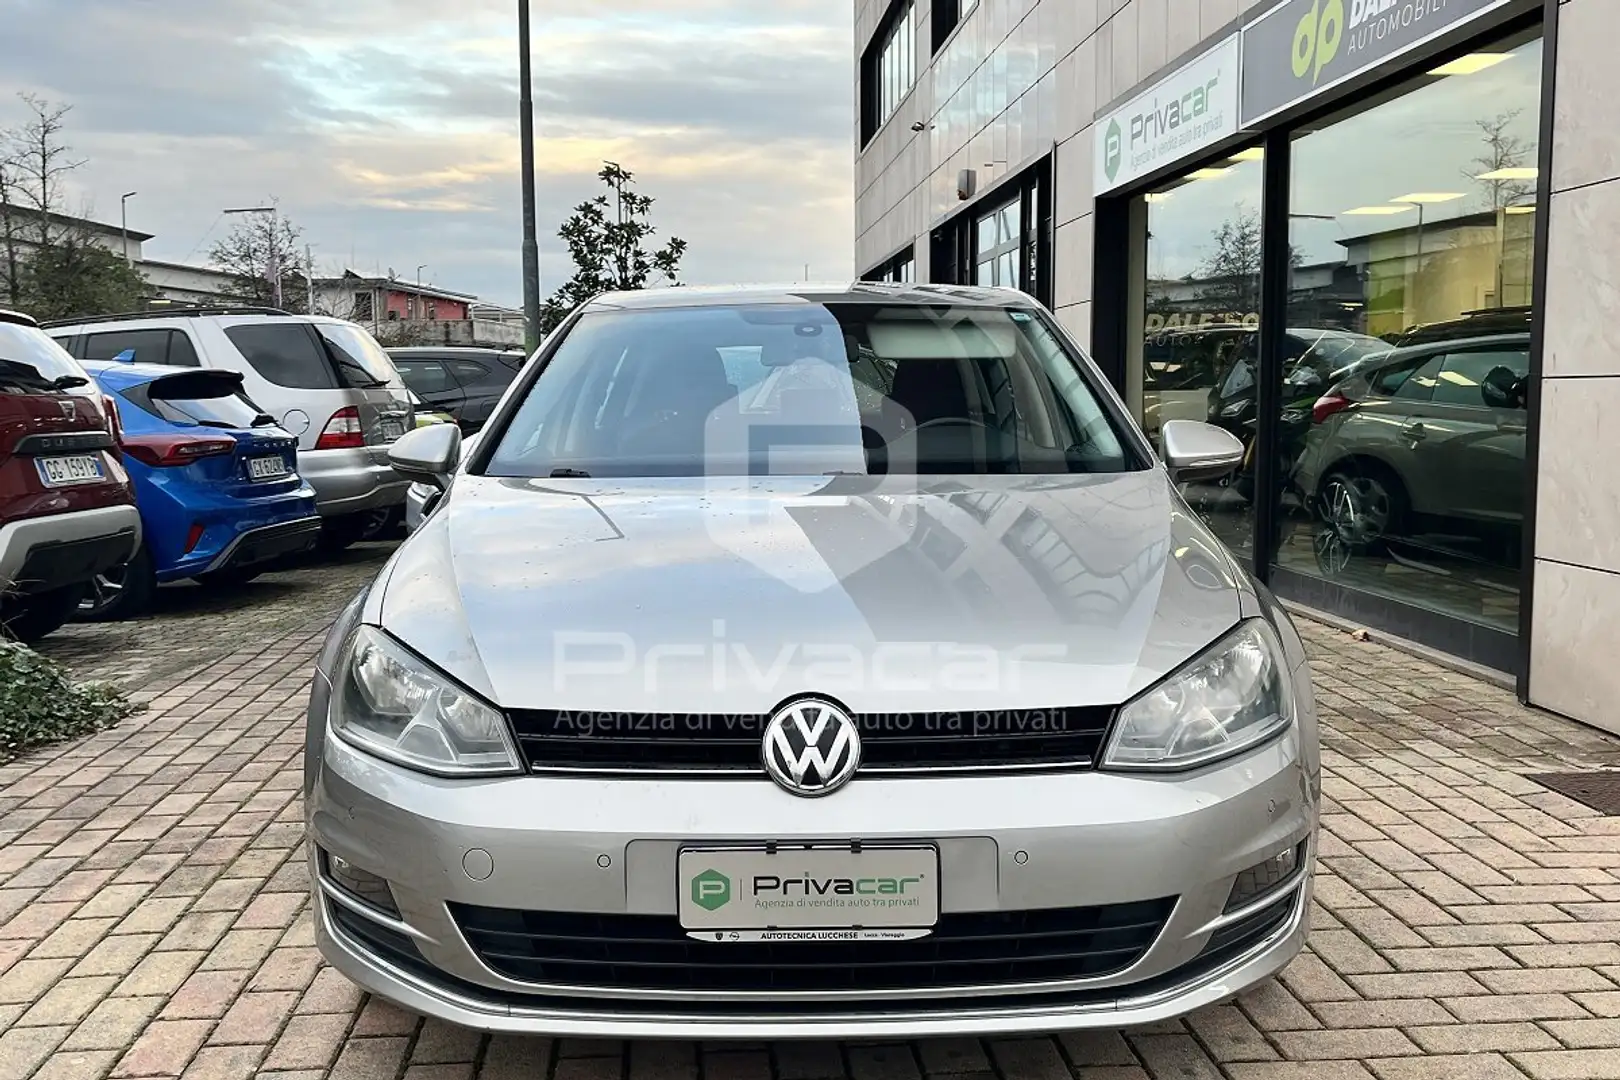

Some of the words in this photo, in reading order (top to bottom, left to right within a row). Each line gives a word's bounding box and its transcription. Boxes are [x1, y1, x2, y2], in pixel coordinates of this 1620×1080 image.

[1347, 0, 1447, 56] AUTOMOBIL
[1348, 0, 1390, 29] DA
[1131, 77, 1218, 150] Privacar
[753, 871, 920, 896] Privacar
[755, 899, 794, 910] Agenzia
[797, 898, 806, 908] di
[808, 898, 845, 908] vendita
[848, 899, 870, 908] auto
[873, 899, 886, 908] tra
[888, 898, 920, 909] privati
[761, 932, 817, 940] AUTOTECNICA
[818, 932, 859, 940] LUCCHESE
